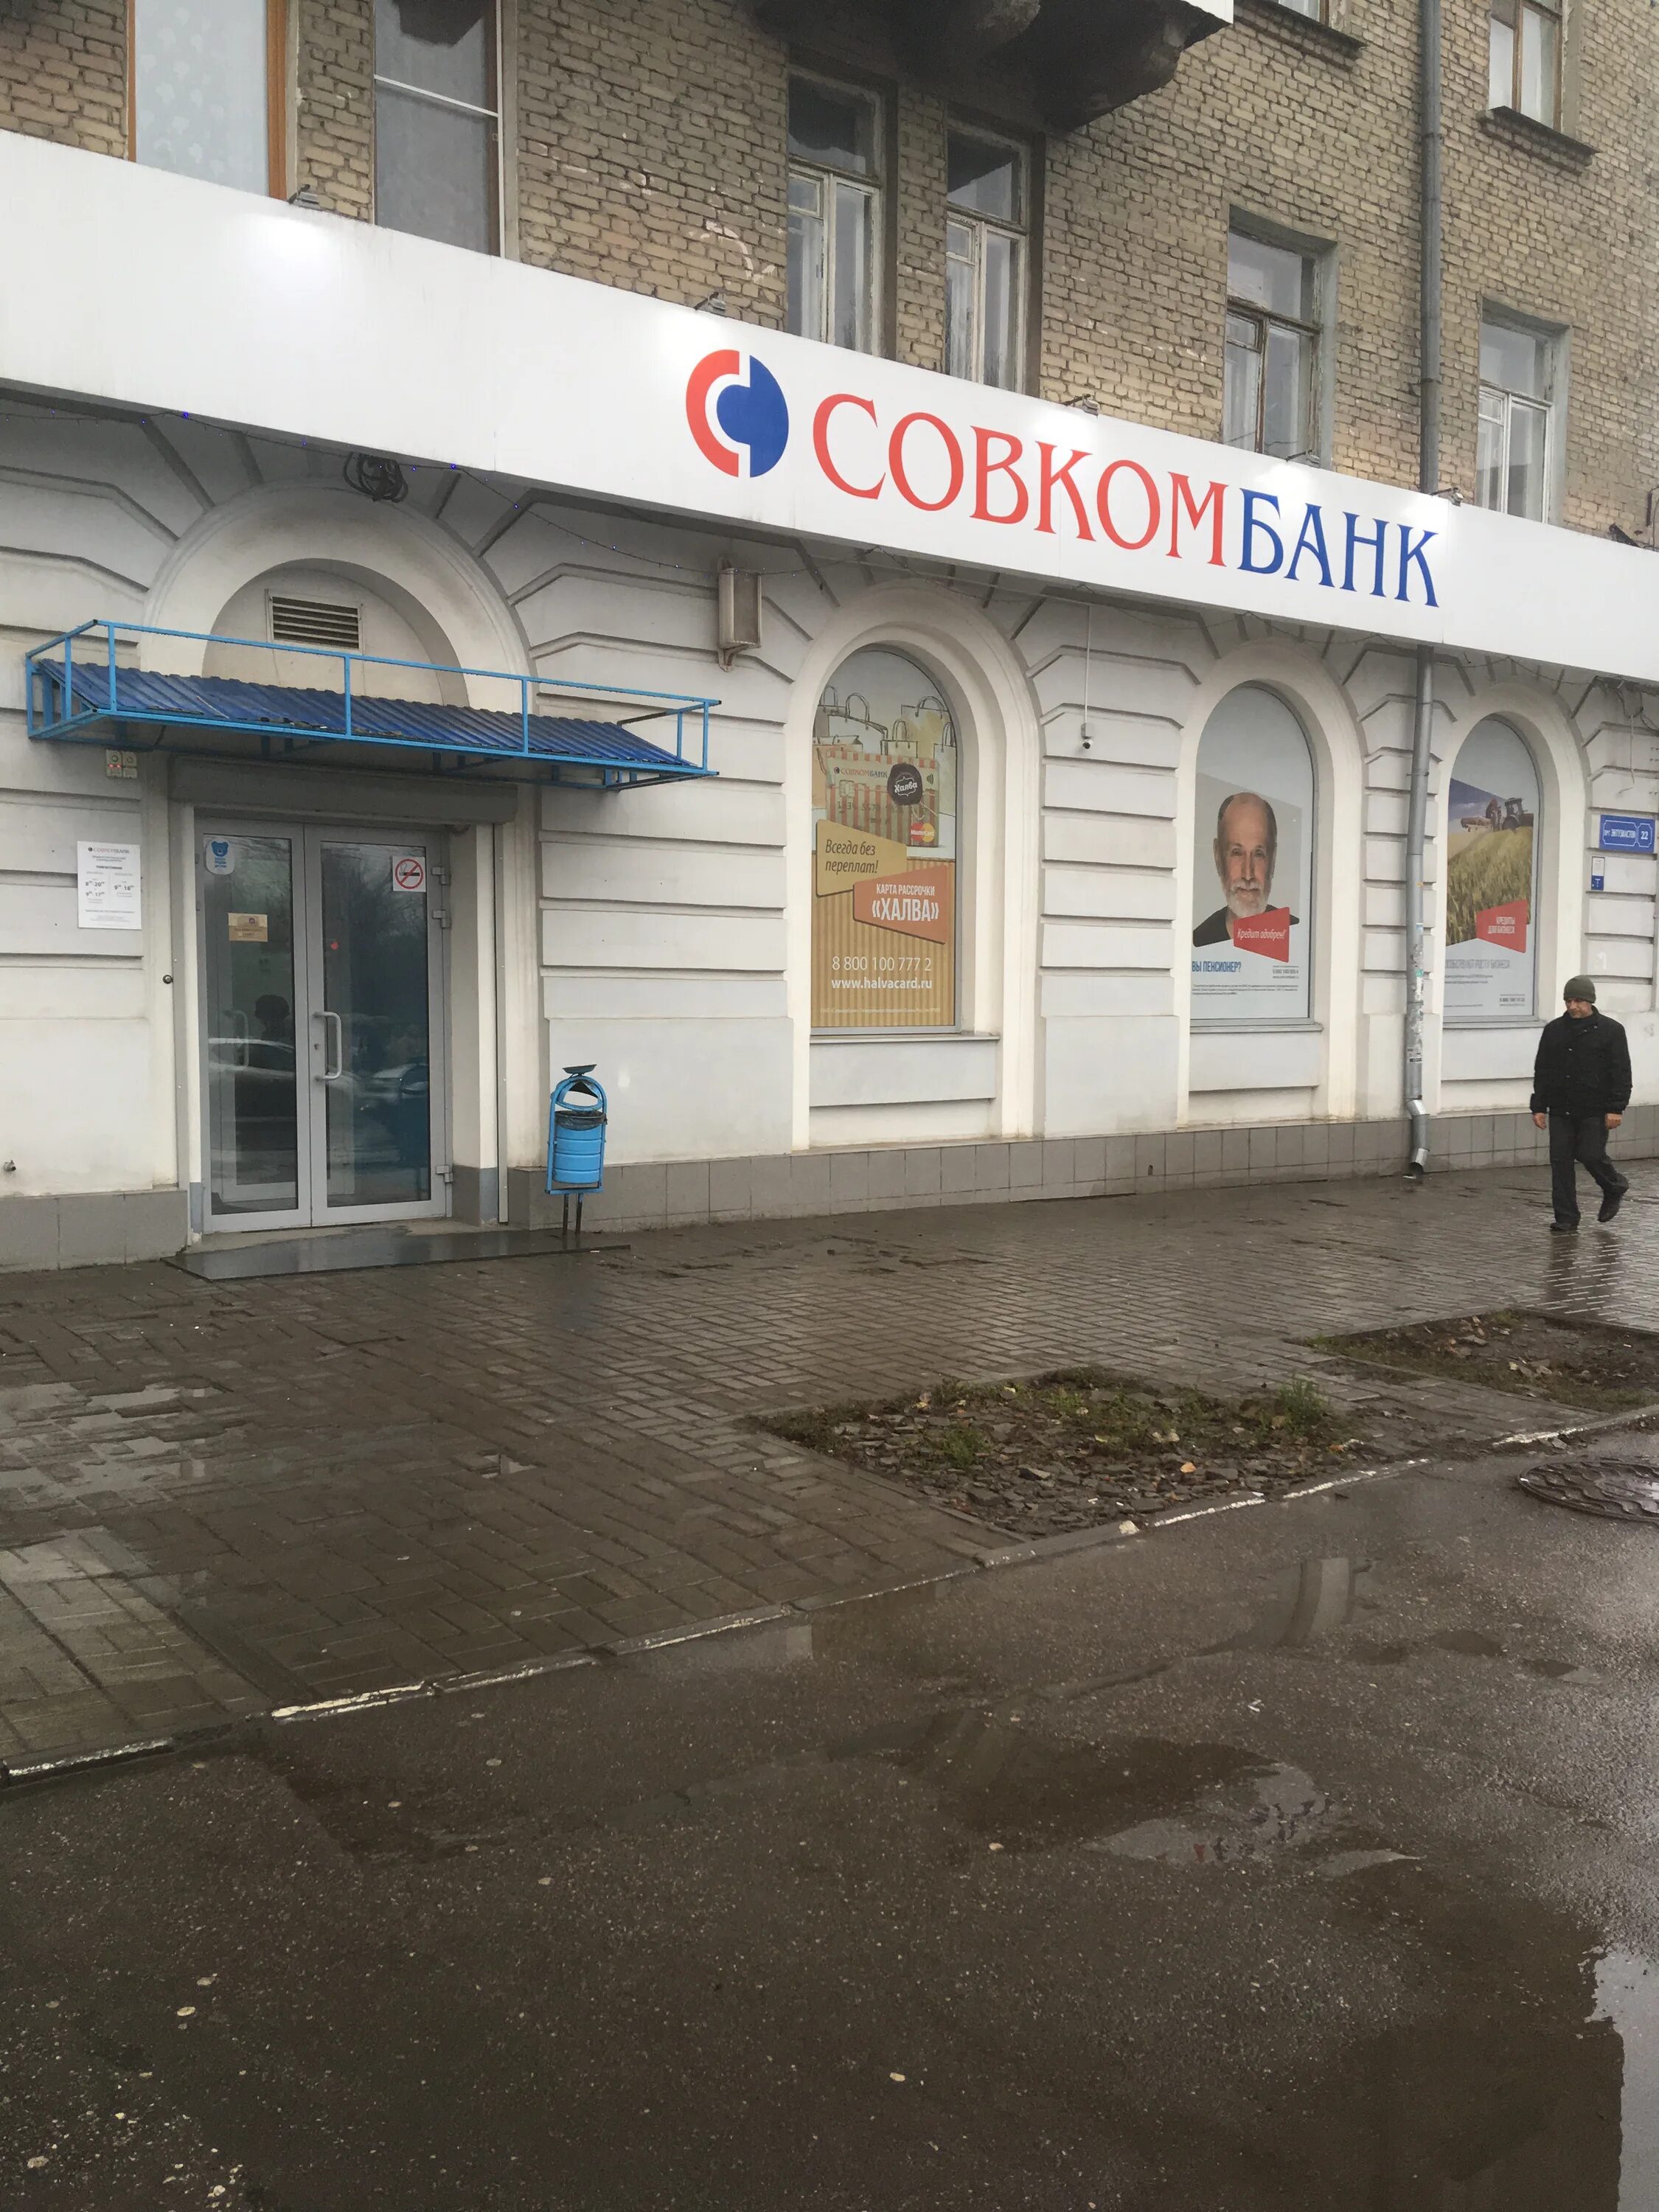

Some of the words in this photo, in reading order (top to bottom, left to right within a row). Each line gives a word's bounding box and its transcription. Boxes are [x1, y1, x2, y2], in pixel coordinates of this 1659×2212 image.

[813, 392, 1440, 608] СОВКОМБАНК
[894, 782, 918, 793] Халва
[1641, 831, 1649, 840] 22
[825, 839, 858, 855] Всегда
[860, 840, 876, 856] без
[825, 860, 879, 876] переплат!
[876, 883, 897, 895] КАРТА
[898, 885, 935, 897] РАССРОЧКИ
[872, 897, 939, 922] «ХАЛВА»
[1237, 928, 1259, 940] Кредит
[832, 956, 841, 970] 8
[844, 956, 868, 971] 800
[872, 956, 894, 971] 100
[898, 956, 921, 971] 777
[924, 957, 932, 971] 2
[1192, 961, 1202, 973] ВЫ
[1203, 961, 1242, 973] ПЕНСИОНЕР?
[831, 976, 933, 989] www.halvacard.ru
